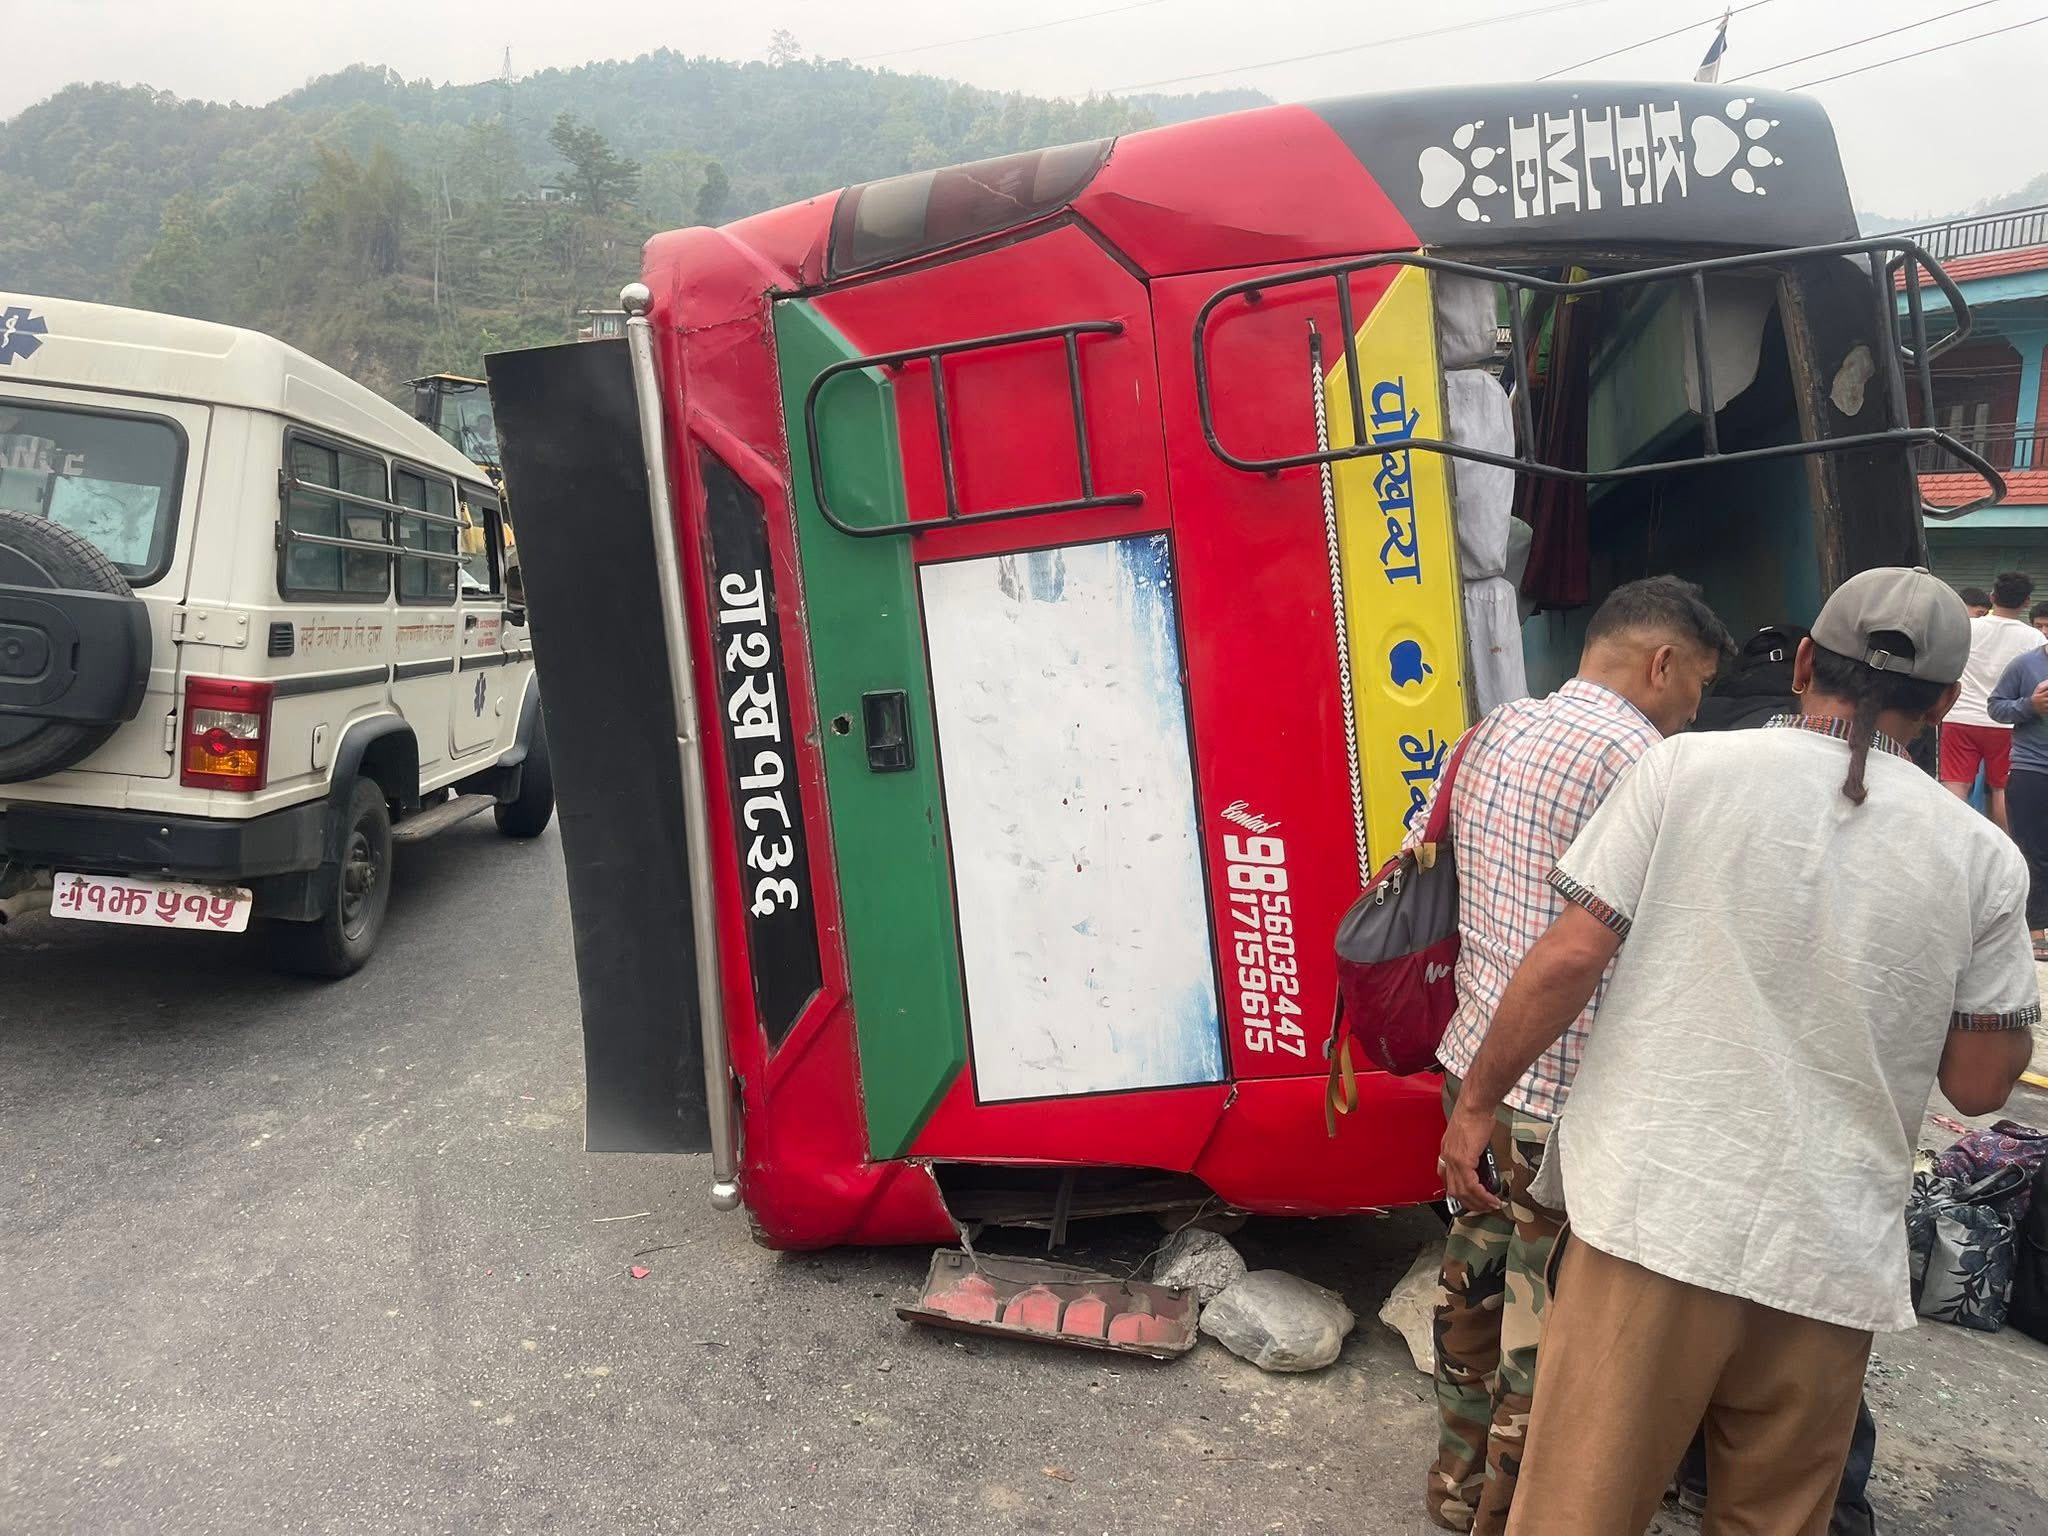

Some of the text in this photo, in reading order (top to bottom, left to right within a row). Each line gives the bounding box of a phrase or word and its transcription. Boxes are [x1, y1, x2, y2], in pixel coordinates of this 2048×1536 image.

[1509, 100, 1687, 219] KELME
[1371, 375, 1423, 586] पोखरा
[1220, 799, 1281, 835] Contact
